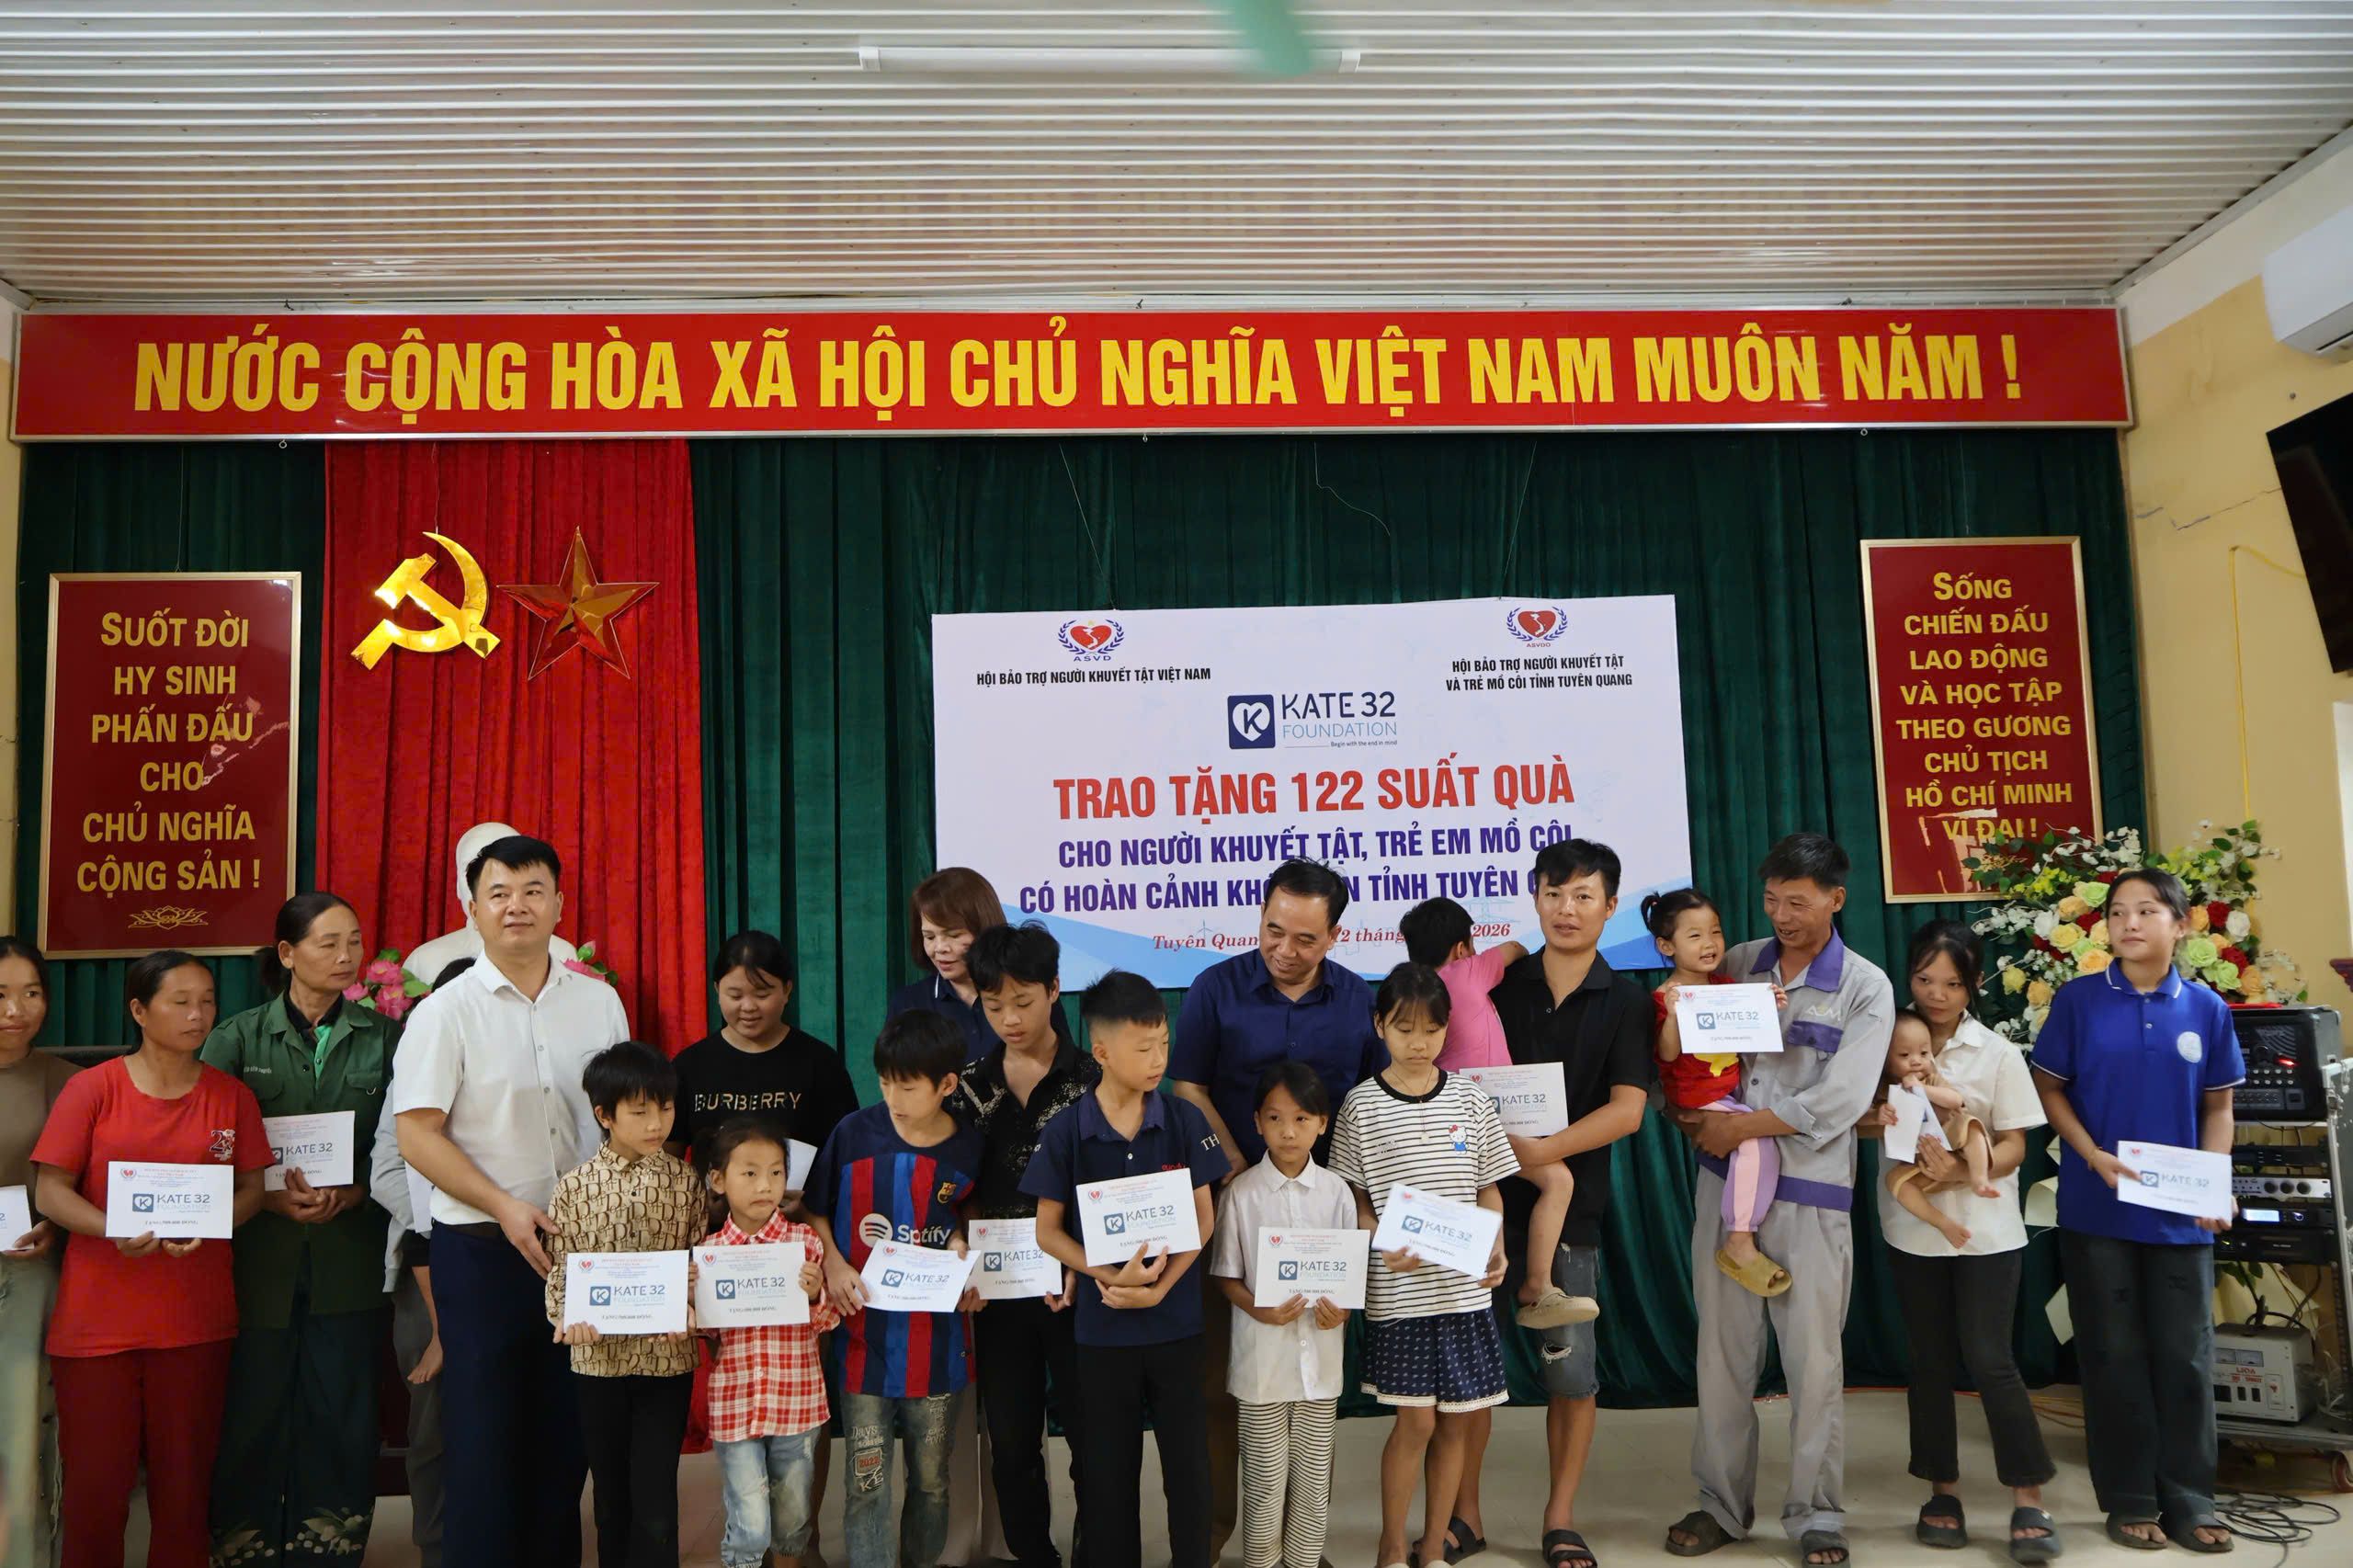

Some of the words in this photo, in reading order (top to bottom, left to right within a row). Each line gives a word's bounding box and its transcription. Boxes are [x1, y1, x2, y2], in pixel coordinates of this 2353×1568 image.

[134, 323, 319, 412] NƯỚC
[346, 327, 526, 425] CỘNG
[551, 326, 682, 410] HÒA
[709, 328, 795, 408] XÃ
[819, 324, 925, 421] HỘI
[950, 315, 1076, 407] CHỦ
[1101, 326, 1298, 406] NGHĨA
[1315, 325, 1447, 417] VIỆT
[1468, 336, 1614, 404] NAM
[1633, 323, 1822, 403] MUÔN
[1837, 323, 1984, 401] NĂM
[2002, 335, 2020, 398] !
[1933, 572, 2012, 600] SỐNG
[101, 608, 188, 647] SUỐT
[195, 610, 249, 648] ĐỜI
[1904, 607, 1983, 636] CHIẾN
[1990, 604, 2049, 633] ĐẤU
[1452, 658, 1471, 675] HỘI
[1474, 656, 1495, 672] BẢO
[1500, 658, 1520, 673] TRỢ
[1524, 655, 1557, 670] NGƯỜI
[1561, 653, 1601, 669] KHUYẾT
[1605, 653, 1624, 670] TẬT
[1909, 649, 1962, 670] LAO
[1970, 643, 2049, 674] ĐỘNG
[114, 666, 156, 695] HY
[165, 665, 236, 695] SINH
[977, 670, 996, 687] HỘI
[999, 669, 1022, 685] BẢO
[1026, 670, 1047, 687] TRỢ
[1051, 668, 1086, 683] NGƯỜI
[1088, 666, 1131, 682] KHUYẾT
[1135, 667, 1154, 684] TẬT
[1158, 666, 1181, 683] VIỆT
[1185, 668, 1211, 680] NAM
[1446, 677, 1461, 691] VÀ
[1463, 676, 1483, 690] TRẺ
[1508, 676, 1526, 688] CÔI
[1529, 673, 1554, 688] TỈNH
[1558, 673, 1592, 687] TUYÊN
[1596, 674, 1632, 687] QUANG
[1282, 692, 1355, 720] KATE
[1361, 691, 1396, 717] 32
[1900, 680, 1938, 705] VÀ
[1946, 683, 2001, 709] HỌC
[2008, 677, 2063, 707] TẬP
[92, 703, 176, 743] PHẤN
[187, 703, 253, 742] ĐẤU
[1282, 722, 1397, 739] FOUNDATION
[1896, 718, 1965, 740] THEO
[1973, 715, 2072, 738] GƯƠNG
[1924, 744, 1979, 773] CHỦ
[1987, 750, 2048, 777] TỊCH
[140, 762, 204, 791] CHO
[1053, 777, 1155, 820] TRAO
[1169, 766, 1277, 825] TẶNG
[1291, 770, 1364, 812] 122
[1378, 752, 1479, 810] SUẤT
[1494, 755, 1575, 810] QUÀ
[1905, 779, 1943, 808] HỒ
[1951, 780, 1995, 807] CHÍ
[2004, 783, 2073, 805] MINH
[83, 801, 147, 843] CHỦ
[158, 804, 256, 842] NGHĨA
[2029, 818, 2037, 837] !
[1059, 840, 1111, 868] CHO
[1120, 831, 1201, 866] NGƯỜI
[1211, 825, 1309, 862] KHUYẾT
[1317, 826, 1368, 865] TẬT,
[1376, 821, 1423, 858] TRẺ
[1432, 828, 1472, 855] EM
[1480, 818, 1521, 853] MỒ
[76, 855, 166, 898] CỘNG
[177, 848, 241, 891] SẢN
[253, 859, 261, 888] !
[1020, 881, 1054, 914] CÓ
[1064, 879, 1137, 912] HOÀN
[1145, 873, 1218, 909] CẢNH
[1369, 866, 1427, 901] TỈNH
[1436, 865, 1518, 898] TUYÊN
[1153, 936, 1206, 951] Tuyên
[1211, 933, 1258, 949] Quan
[1472, 924, 1510, 937] 2026
[1716, 1012, 1745, 1020] KATE
[1746, 1011, 1759, 1020] 32
[695, 1092, 801, 1112] BURBERRY
[1502, 1095, 1530, 1105] KATE
[1532, 1094, 1546, 1103] 32
[286, 1144, 316, 1155] KATE
[318, 1142, 333, 1153] 32
[157, 1194, 191, 1204] KATE
[194, 1194, 210, 1204] 32
[1126, 1207, 1157, 1221] KATE
[1159, 1205, 1175, 1217] 32
[897, 1224, 951, 1244] Sptify
[1425, 1221, 1454, 1238] KATE
[1004, 1250, 1031, 1261] KATE
[1033, 1249, 1044, 1259] 32
[1301, 1261, 1330, 1271] KATE
[1332, 1261, 1347, 1272] 32
[614, 1285, 647, 1296] KATE
[649, 1284, 665, 1295] 32
[737, 1278, 768, 1289] KATE
[770, 1277, 786, 1288] 32
[904, 1272, 935, 1283] KATE
[937, 1274, 950, 1283] 32
